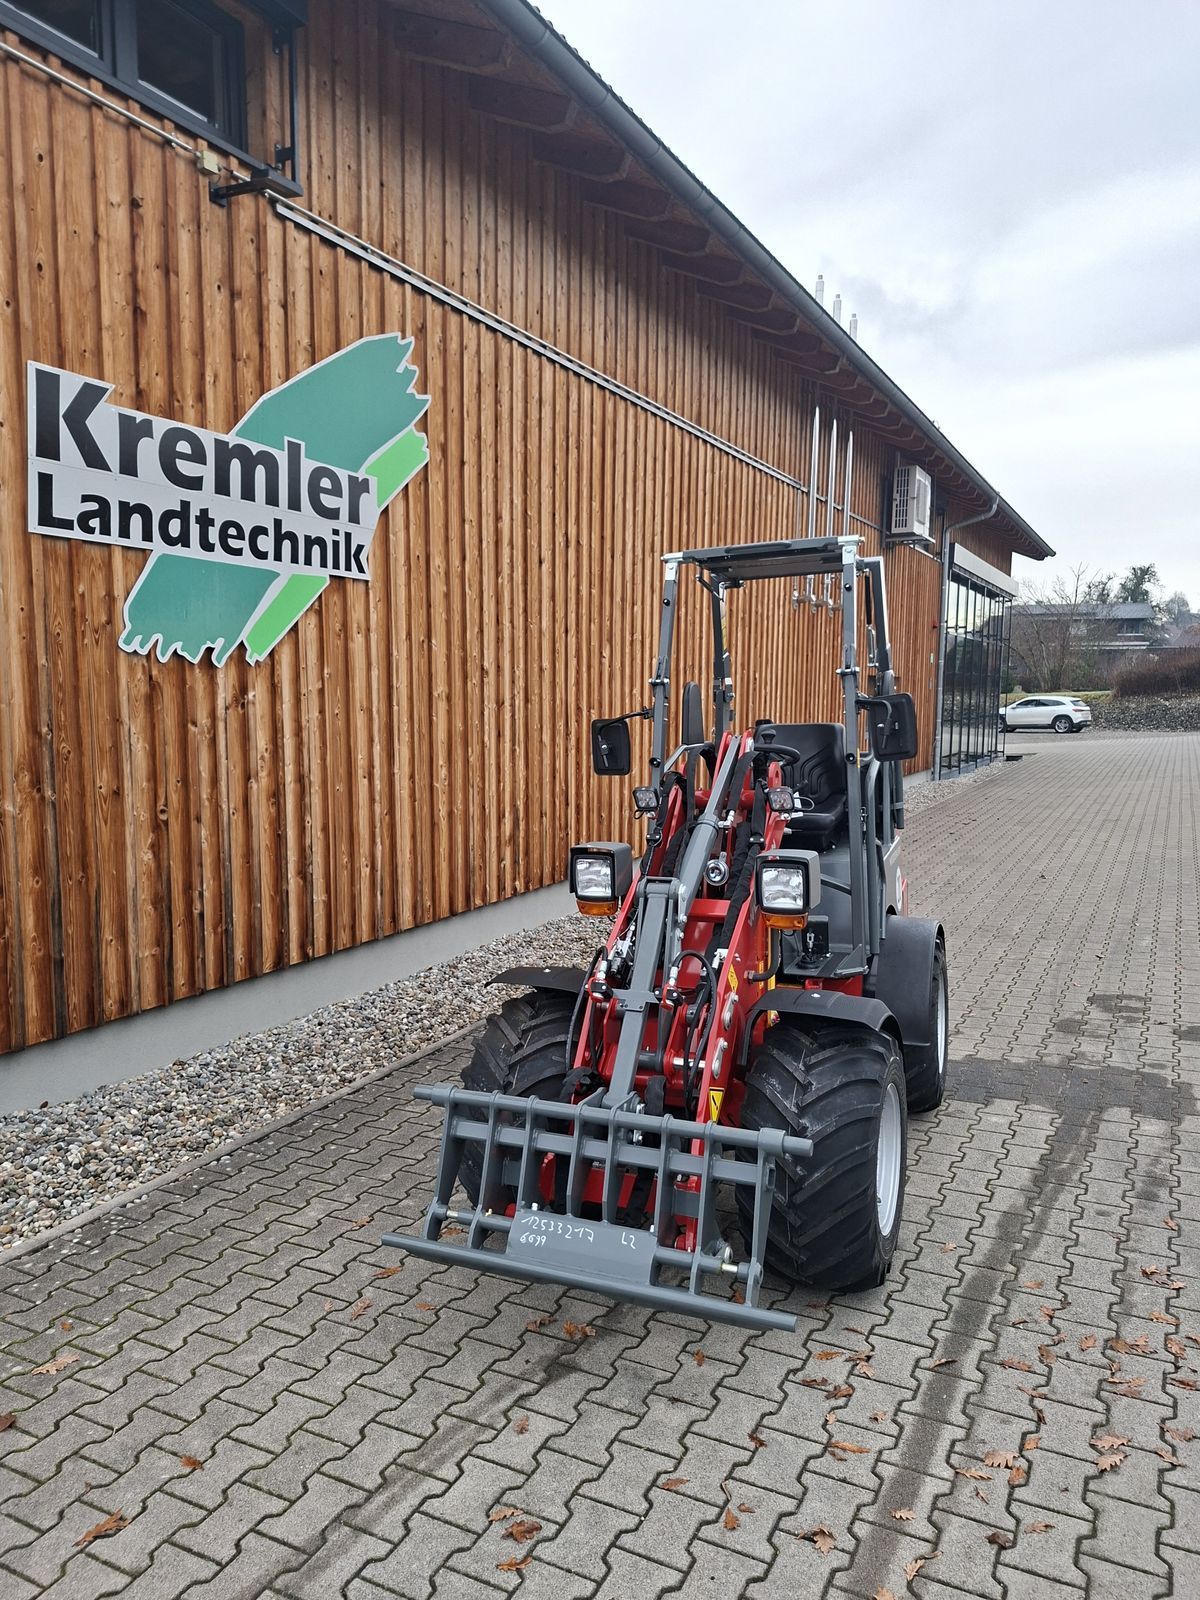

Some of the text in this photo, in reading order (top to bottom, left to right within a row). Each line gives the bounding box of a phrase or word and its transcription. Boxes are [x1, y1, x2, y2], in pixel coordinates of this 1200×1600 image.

[35, 367, 371, 525] Kremler
[37, 471, 368, 574] Landtechnik
[521, 1215, 594, 1243] 12533217
